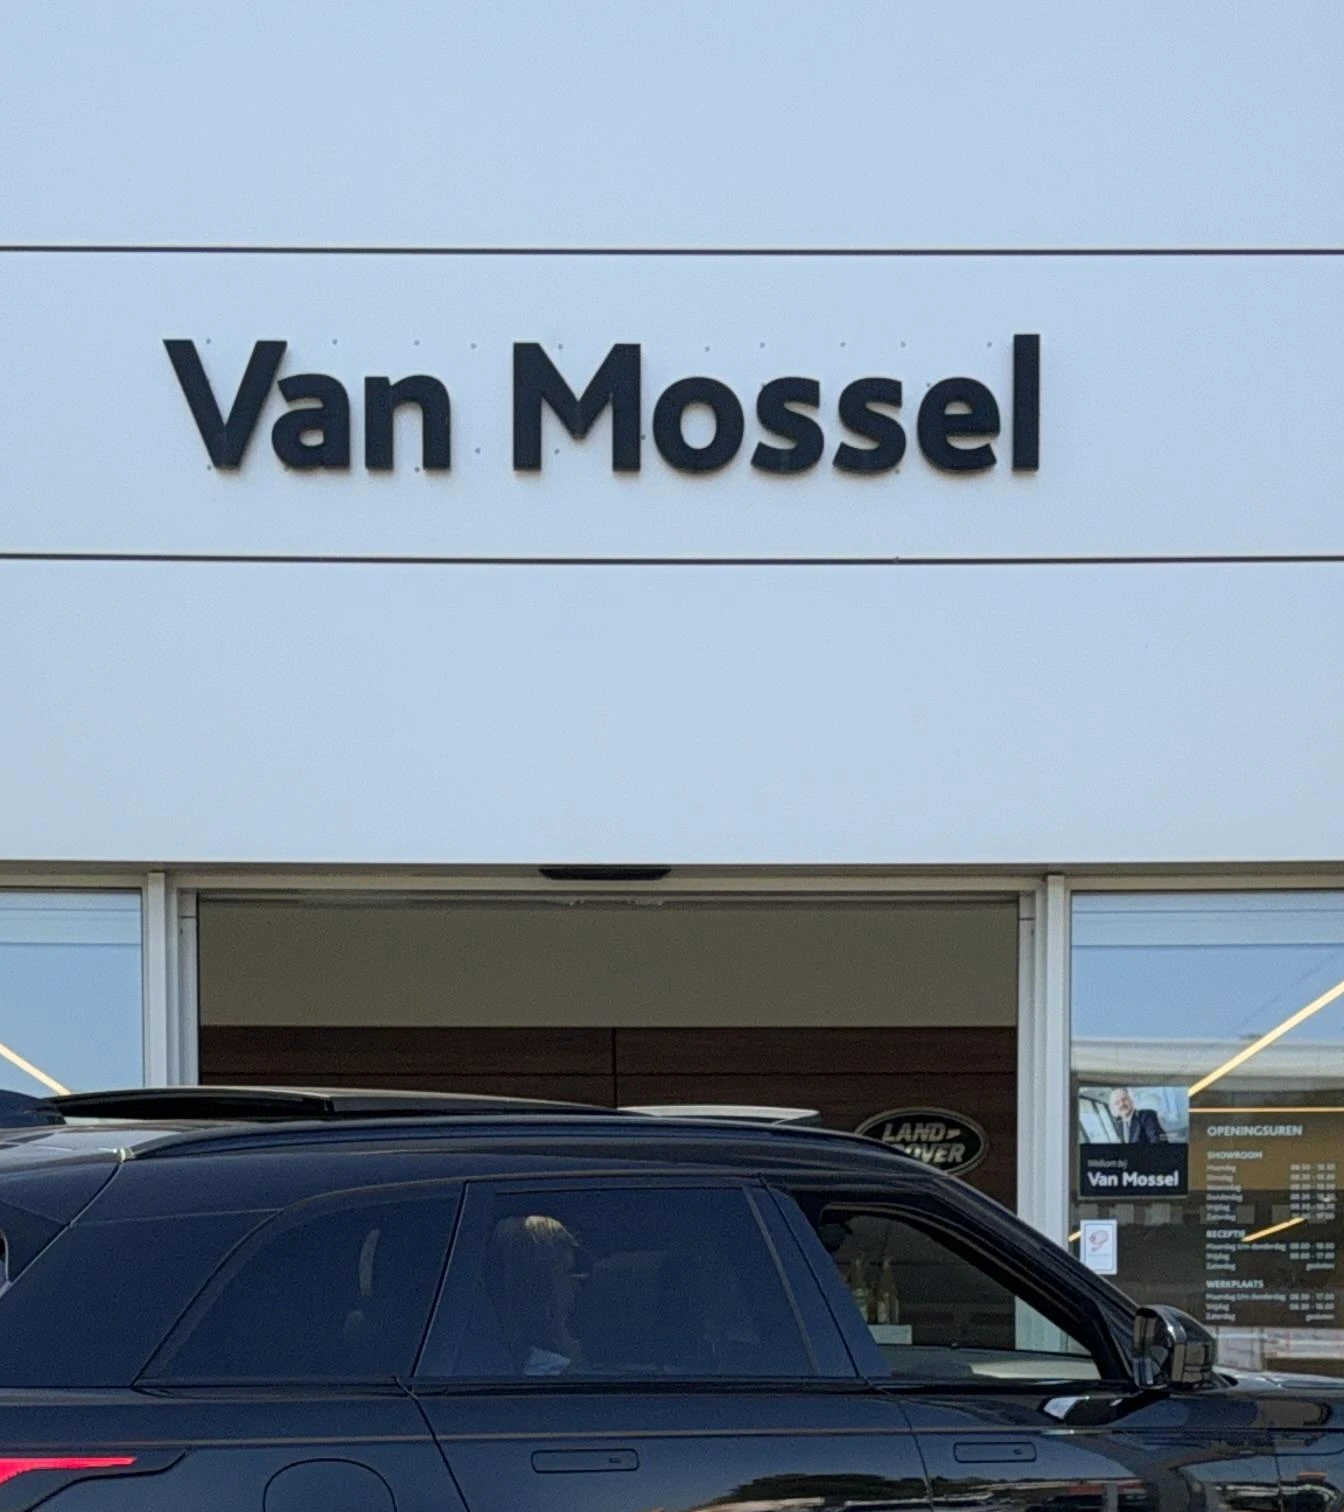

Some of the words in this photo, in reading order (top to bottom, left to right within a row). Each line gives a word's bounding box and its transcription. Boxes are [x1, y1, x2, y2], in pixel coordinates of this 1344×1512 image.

[163, 338, 452, 471] Van
[512, 333, 1042, 474] Mossel
[881, 1121, 948, 1143] LAND
[1206, 1125, 1304, 1137] OPENINGSUREN
[1206, 1151, 1263, 1160] SHOWROOM
[1087, 1171, 1119, 1187] Van
[1122, 1170, 1179, 1187] Mossel
[1206, 1280, 1264, 1289] WERKPLAATS
